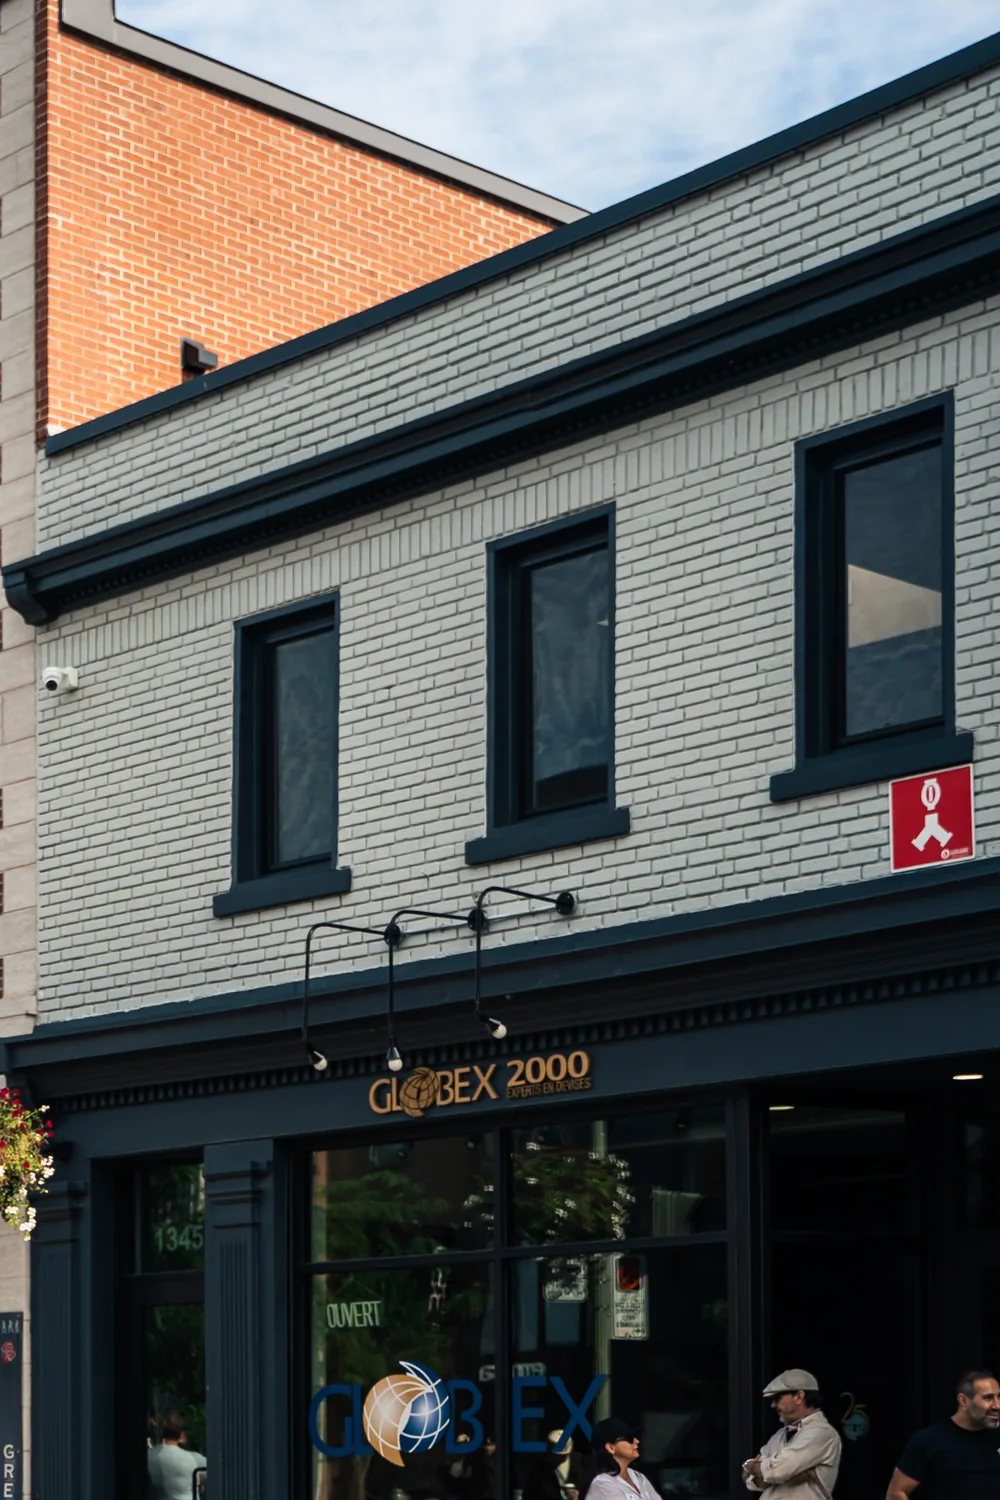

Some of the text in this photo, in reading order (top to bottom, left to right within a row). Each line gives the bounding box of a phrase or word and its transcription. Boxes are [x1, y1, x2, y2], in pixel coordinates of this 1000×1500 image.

[506, 1051, 590, 1087] 2000
[507, 1076, 592, 1099] EXPERTS EN DEVISES
[155, 1225, 203, 1252] 1345
[327, 1301, 381, 1328] OUVERT
